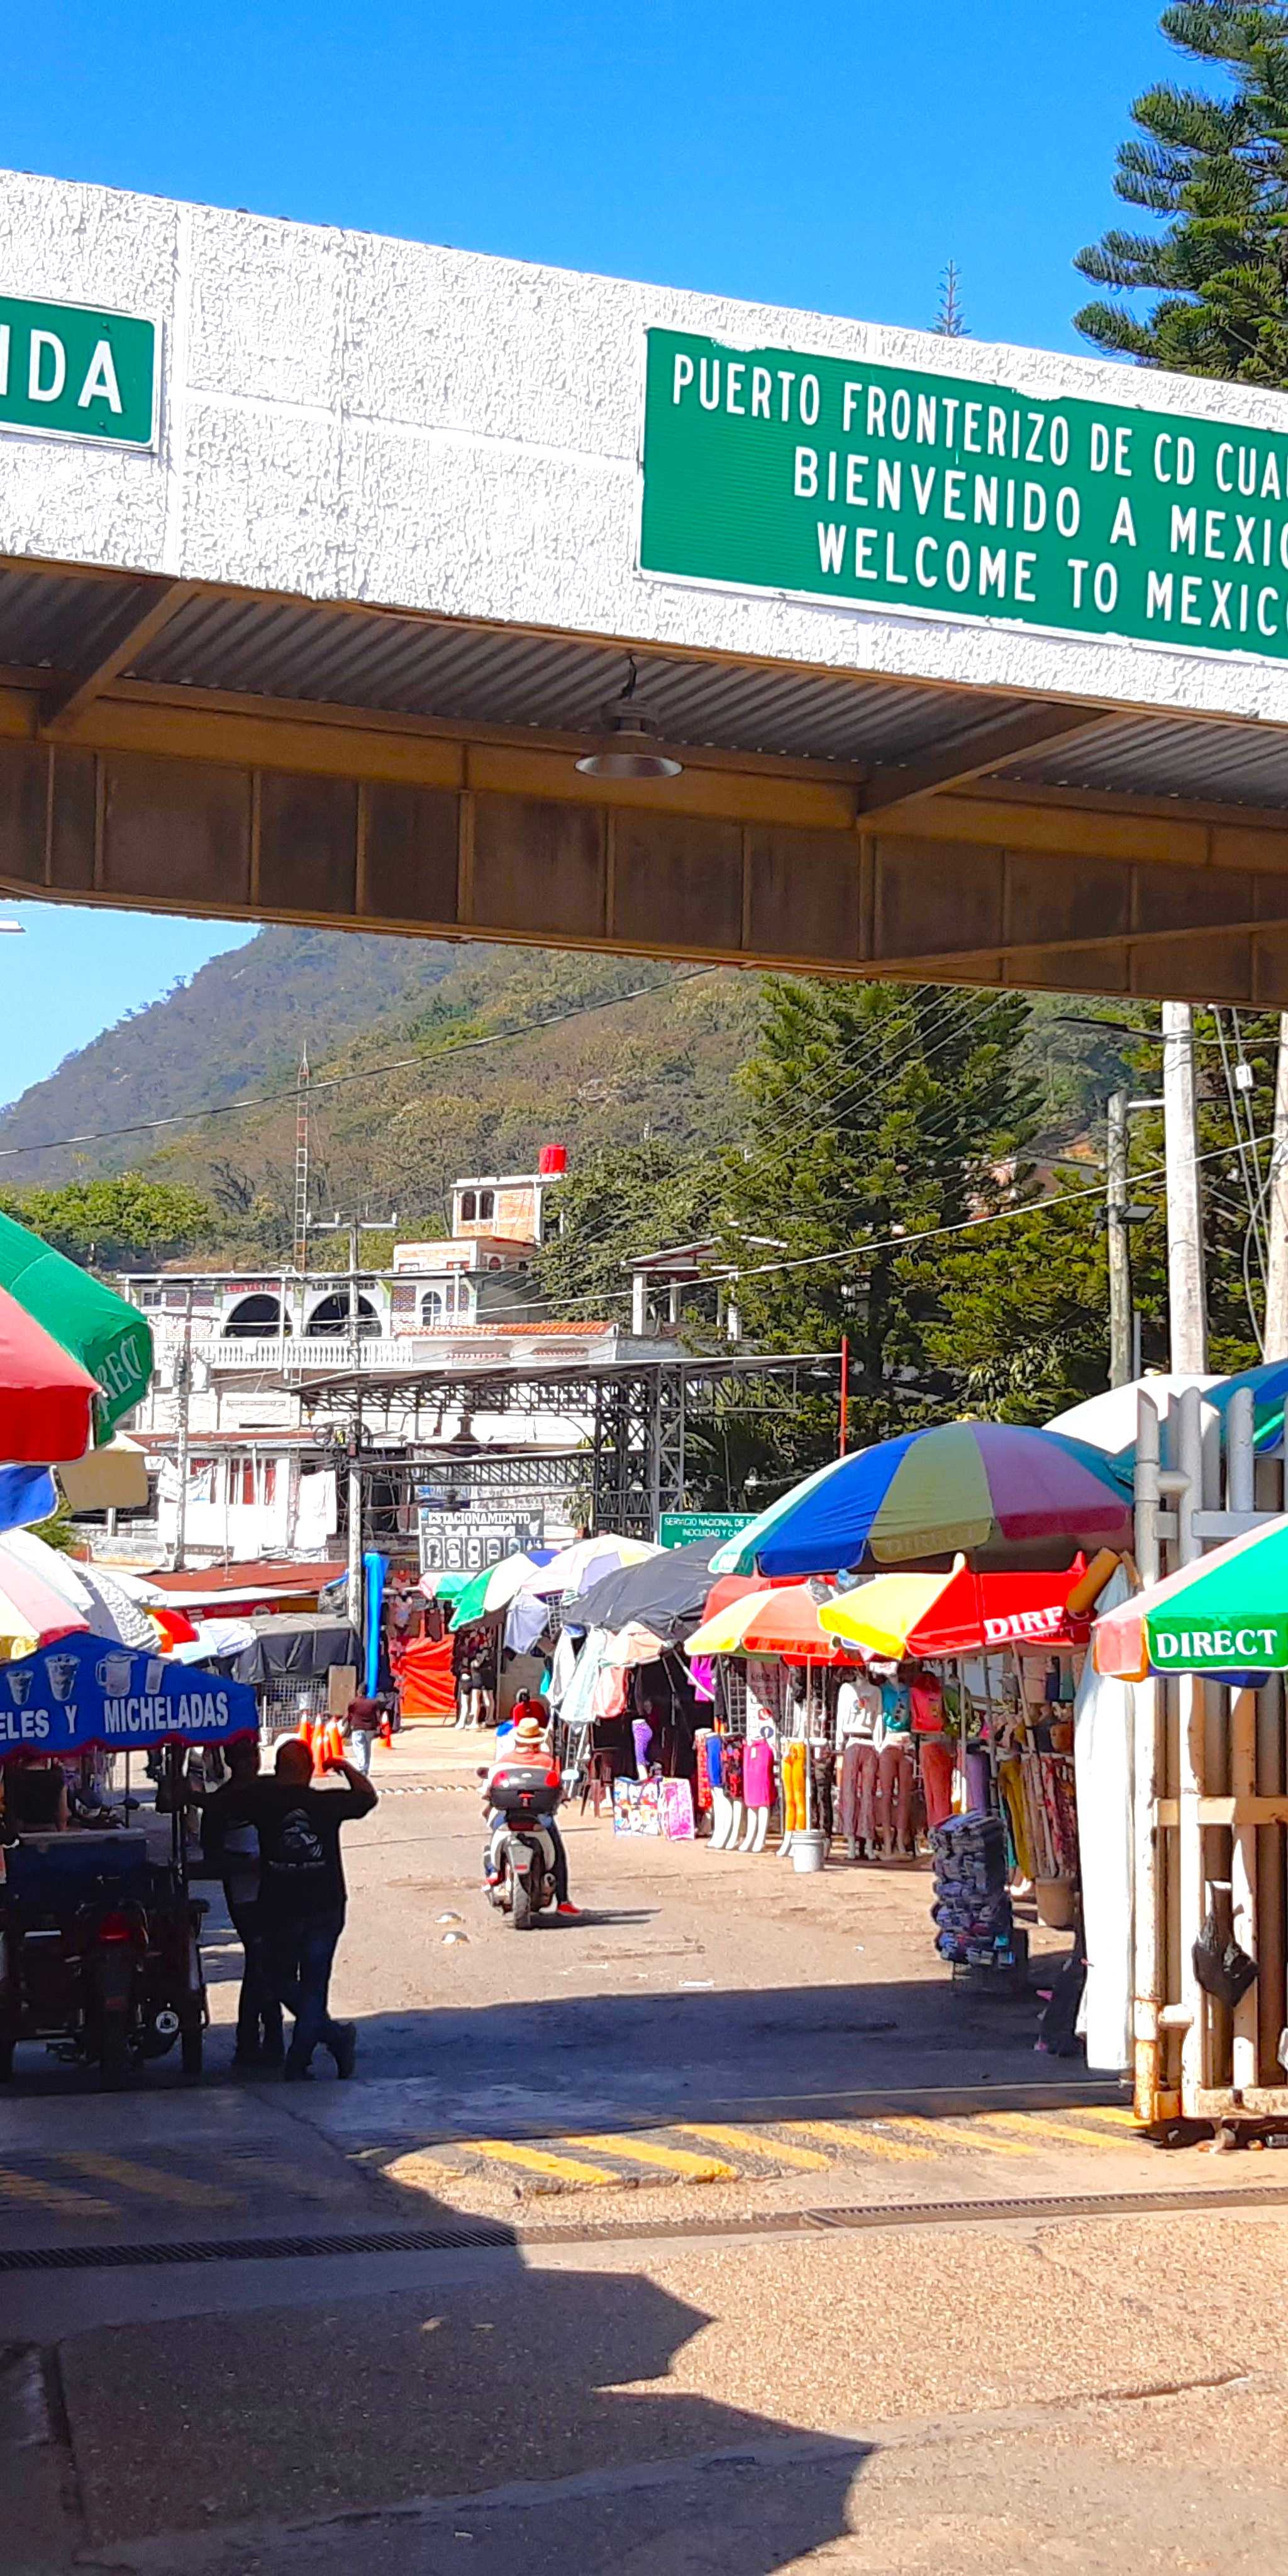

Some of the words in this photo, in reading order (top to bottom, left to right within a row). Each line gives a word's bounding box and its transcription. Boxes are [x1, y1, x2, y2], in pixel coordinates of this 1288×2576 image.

[673, 353, 819, 425] PUERTO
[843, 381, 1069, 467] FRONTERIZO
[1090, 423, 1132, 476] DE
[1153, 433, 1195, 485] CD
[1216, 442, 1288, 502] CUA
[794, 446, 1080, 537] BIENVENIDO
[1110, 497, 1137, 547] A
[818, 521, 1037, 602] WELCOME
[1067, 558, 1118, 613] TO
[1146, 570, 1288, 636] MEXIC
[428, 1512, 531, 1524] ESTACIONAMIENTO
[664, 1517, 697, 1526] SERVICIO
[698, 1518, 733, 1527] NACIONAL
[734, 1518, 745, 1528] DE
[1155, 1629, 1278, 1658] DIRECT
[65, 1704, 77, 1734] Y
[104, 1691, 228, 1734] MICHELADAS
